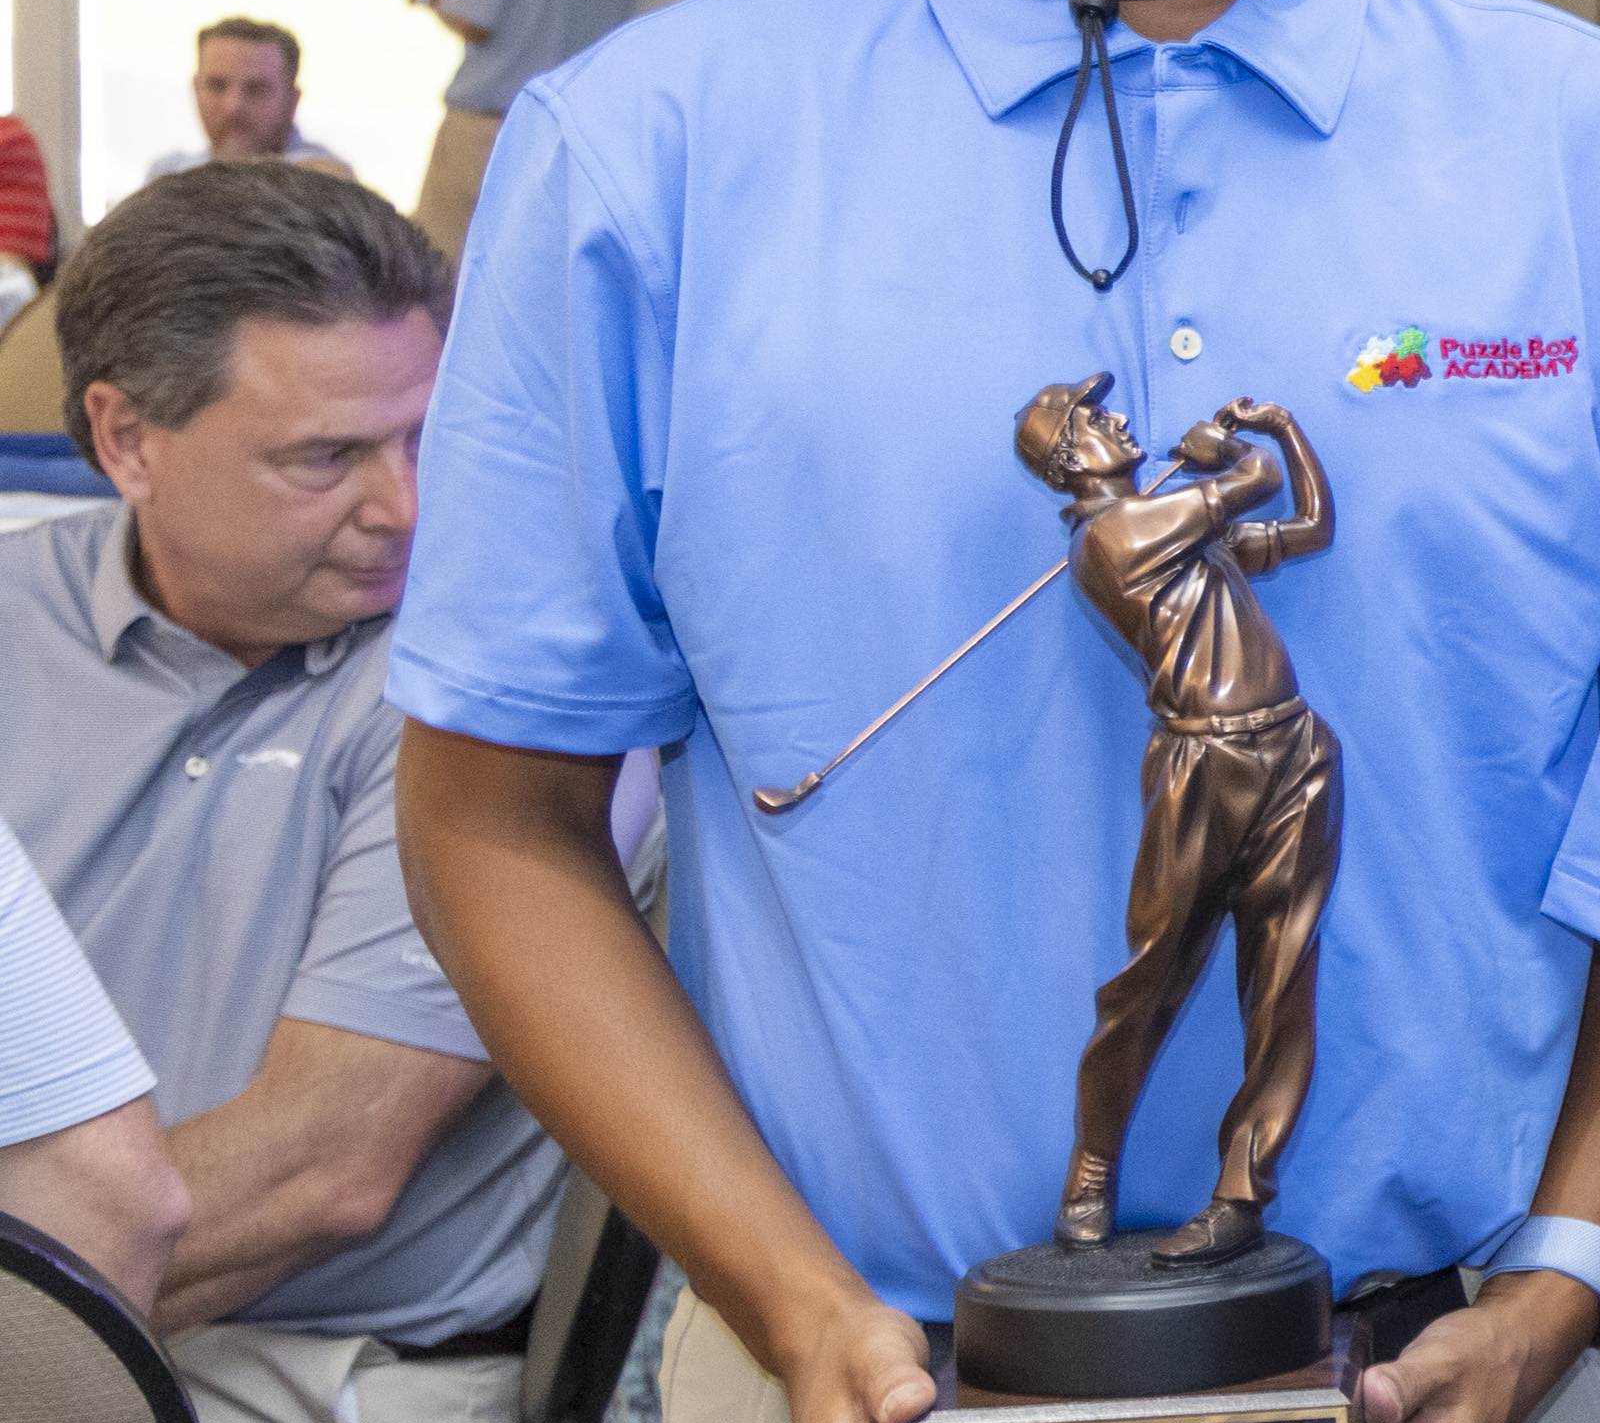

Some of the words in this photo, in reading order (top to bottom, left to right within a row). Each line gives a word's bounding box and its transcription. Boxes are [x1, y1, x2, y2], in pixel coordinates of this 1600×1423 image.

[1439, 338, 1522, 360] Puzzle
[1527, 337, 1578, 359] Box
[1443, 355, 1577, 379] ACADEMY
